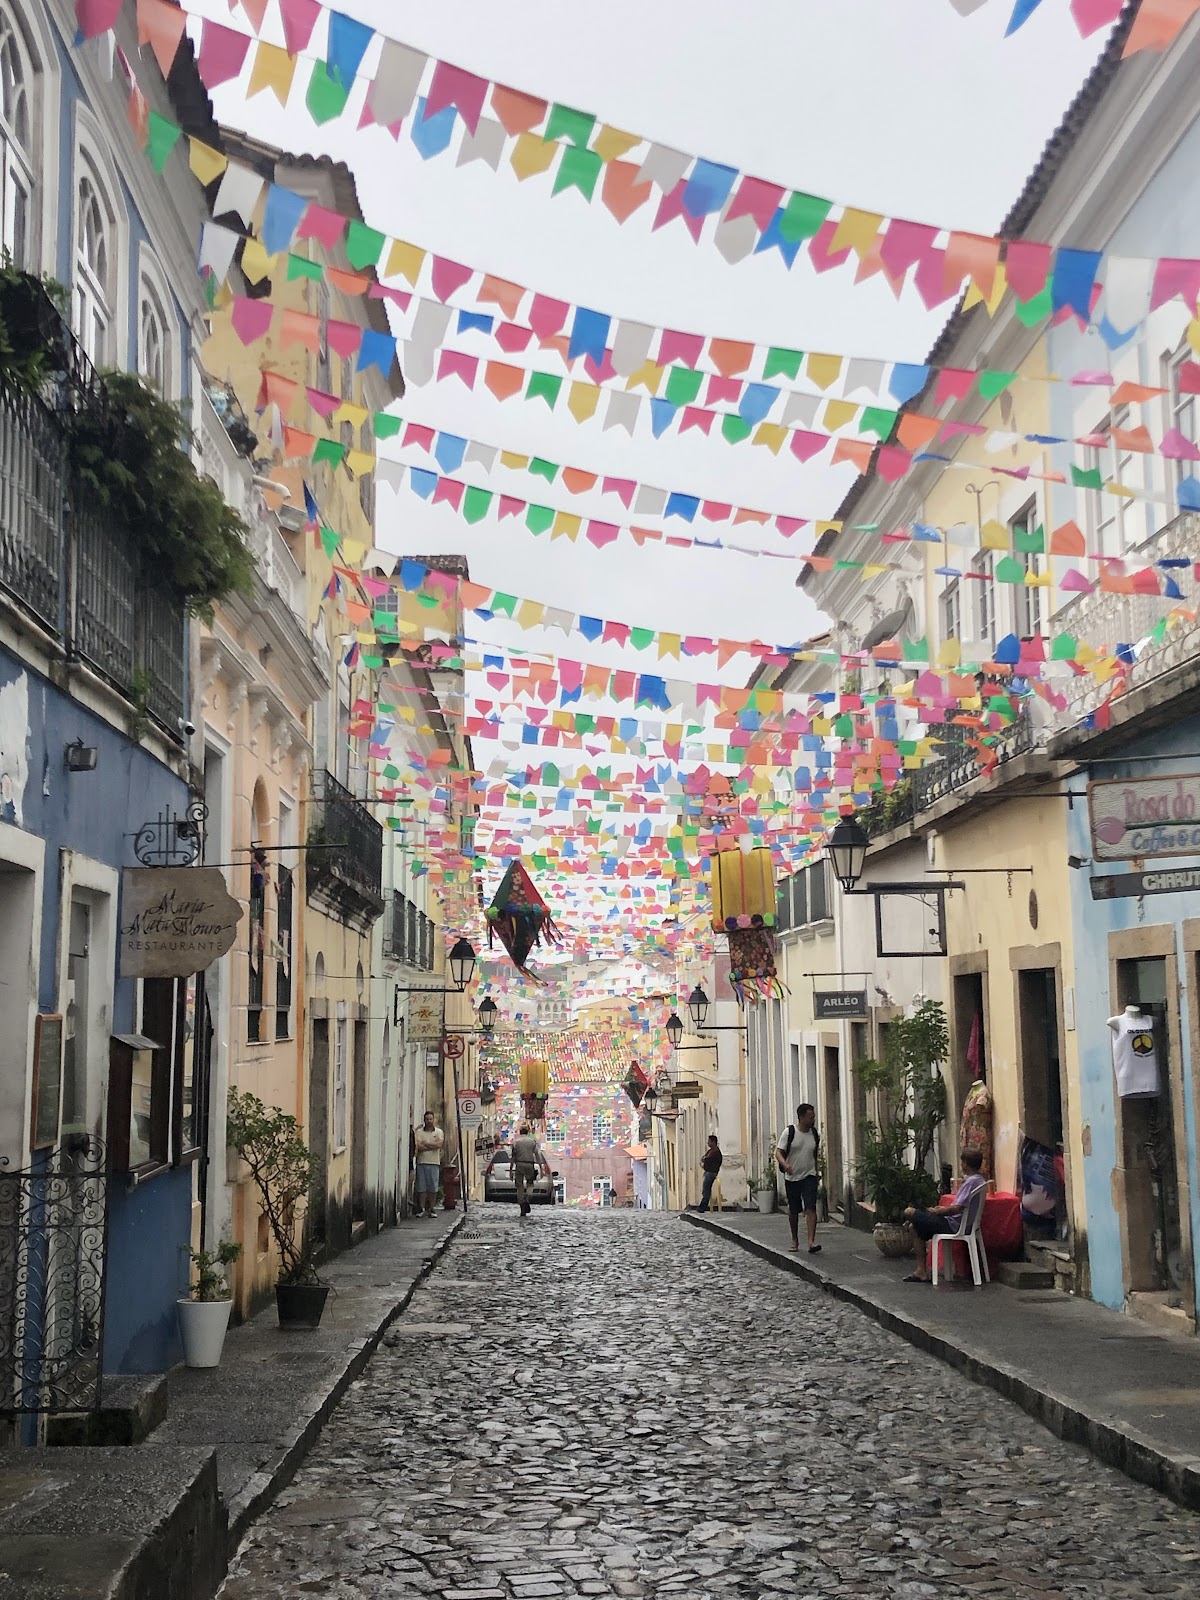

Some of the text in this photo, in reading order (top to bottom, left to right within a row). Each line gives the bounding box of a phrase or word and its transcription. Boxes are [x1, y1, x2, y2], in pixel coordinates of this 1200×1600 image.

[1121, 781, 1195, 822] Rosa do
[128, 941, 223, 951] RESTAURANTE
[823, 995, 859, 1007] ARLÉO
[465, 1102, 472, 1112] E
